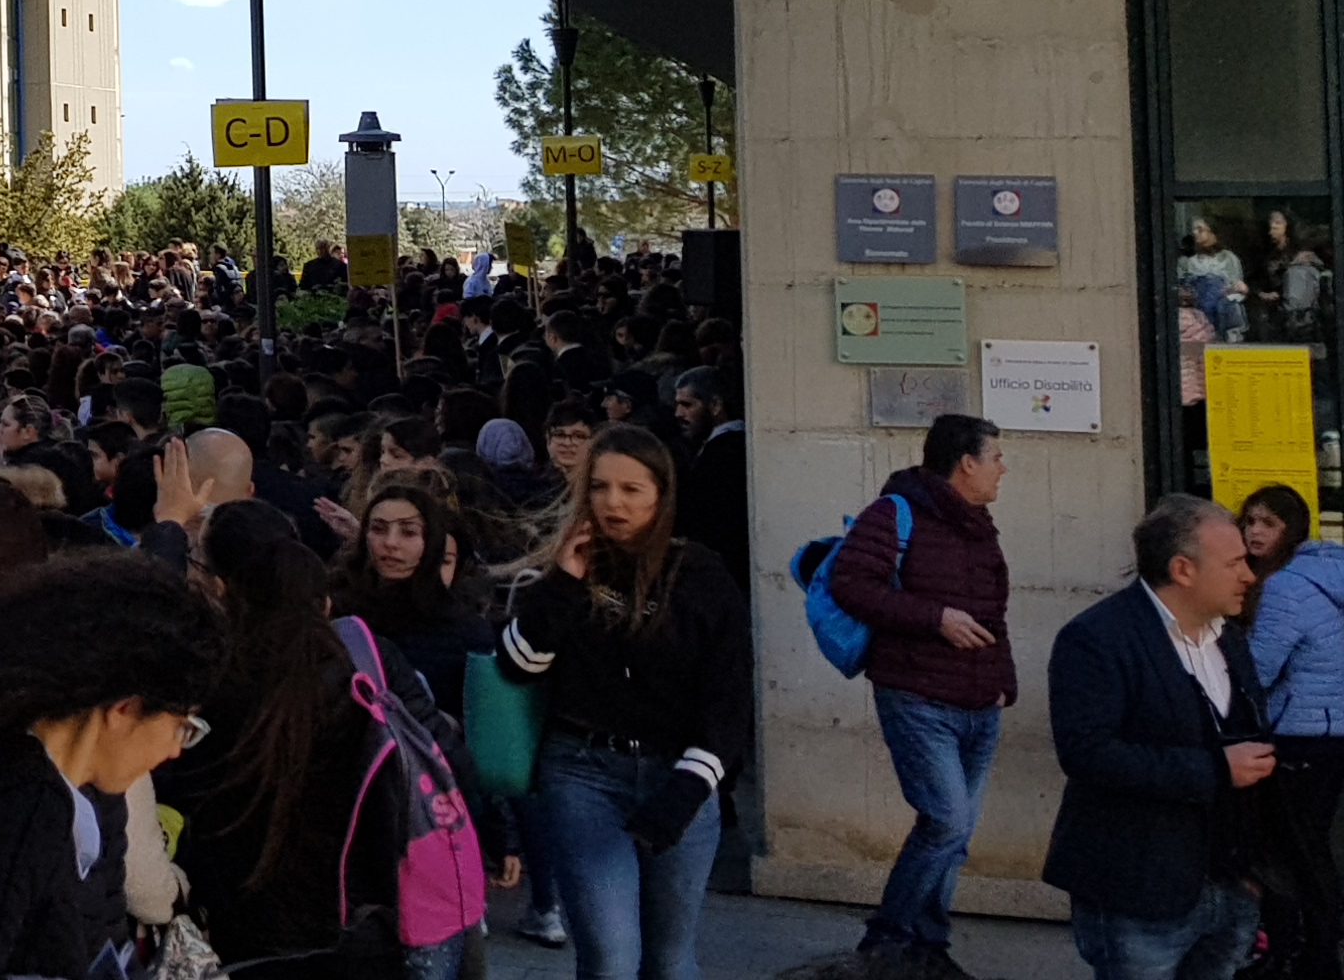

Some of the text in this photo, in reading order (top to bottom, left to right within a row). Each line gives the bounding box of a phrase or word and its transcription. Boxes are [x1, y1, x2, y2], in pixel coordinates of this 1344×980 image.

[225, 116, 290, 148] C-D
[545, 144, 595, 164] M-O
[697, 160, 722, 174] S-Z
[990, 378, 1093, 392] Ufficio Disabilità
